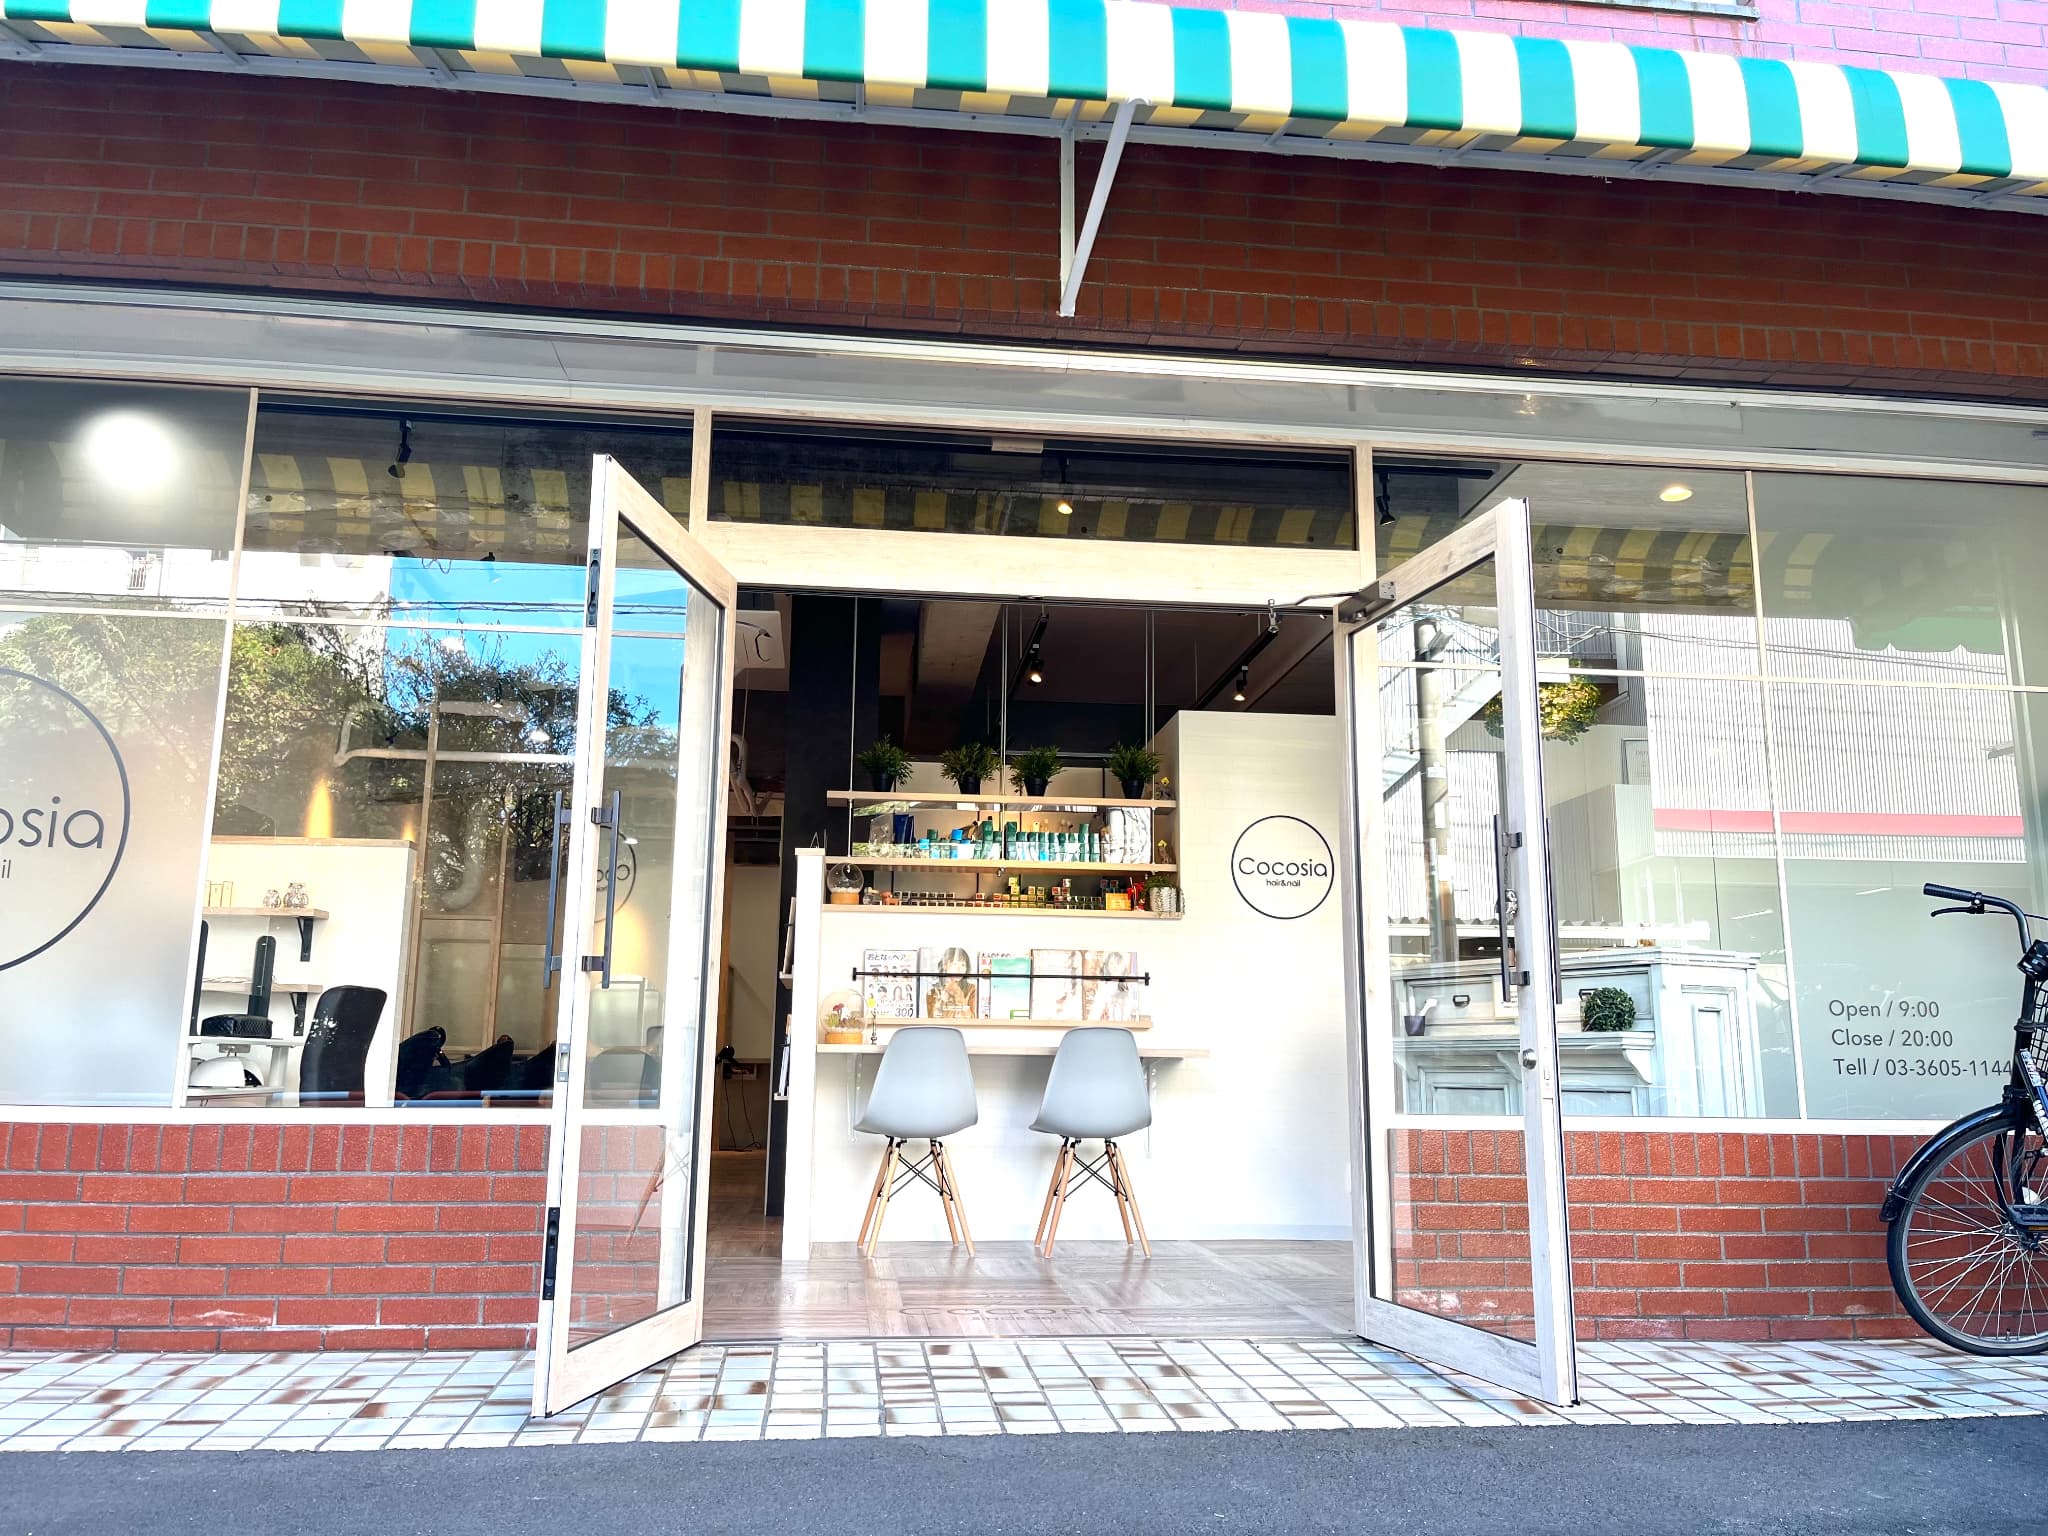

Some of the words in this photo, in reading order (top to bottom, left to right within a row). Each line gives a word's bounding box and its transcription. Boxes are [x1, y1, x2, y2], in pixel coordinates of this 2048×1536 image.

[1238, 856, 1328, 878] Cocosia
[1265, 879, 1301, 888] hair&nail
[1828, 999, 1881, 1021] Open
[1886, 1000, 1893, 1017] /
[1899, 1000, 1940, 1018] 9:00
[1831, 1028, 1883, 1047] Close
[1888, 1029, 1895, 1047] /
[1901, 1029, 1953, 1048] 20:00
[1833, 1058, 1867, 1076] Tell
[1872, 1058, 1880, 1076] /
[1885, 1059, 2013, 1077] 03-3605-1144
